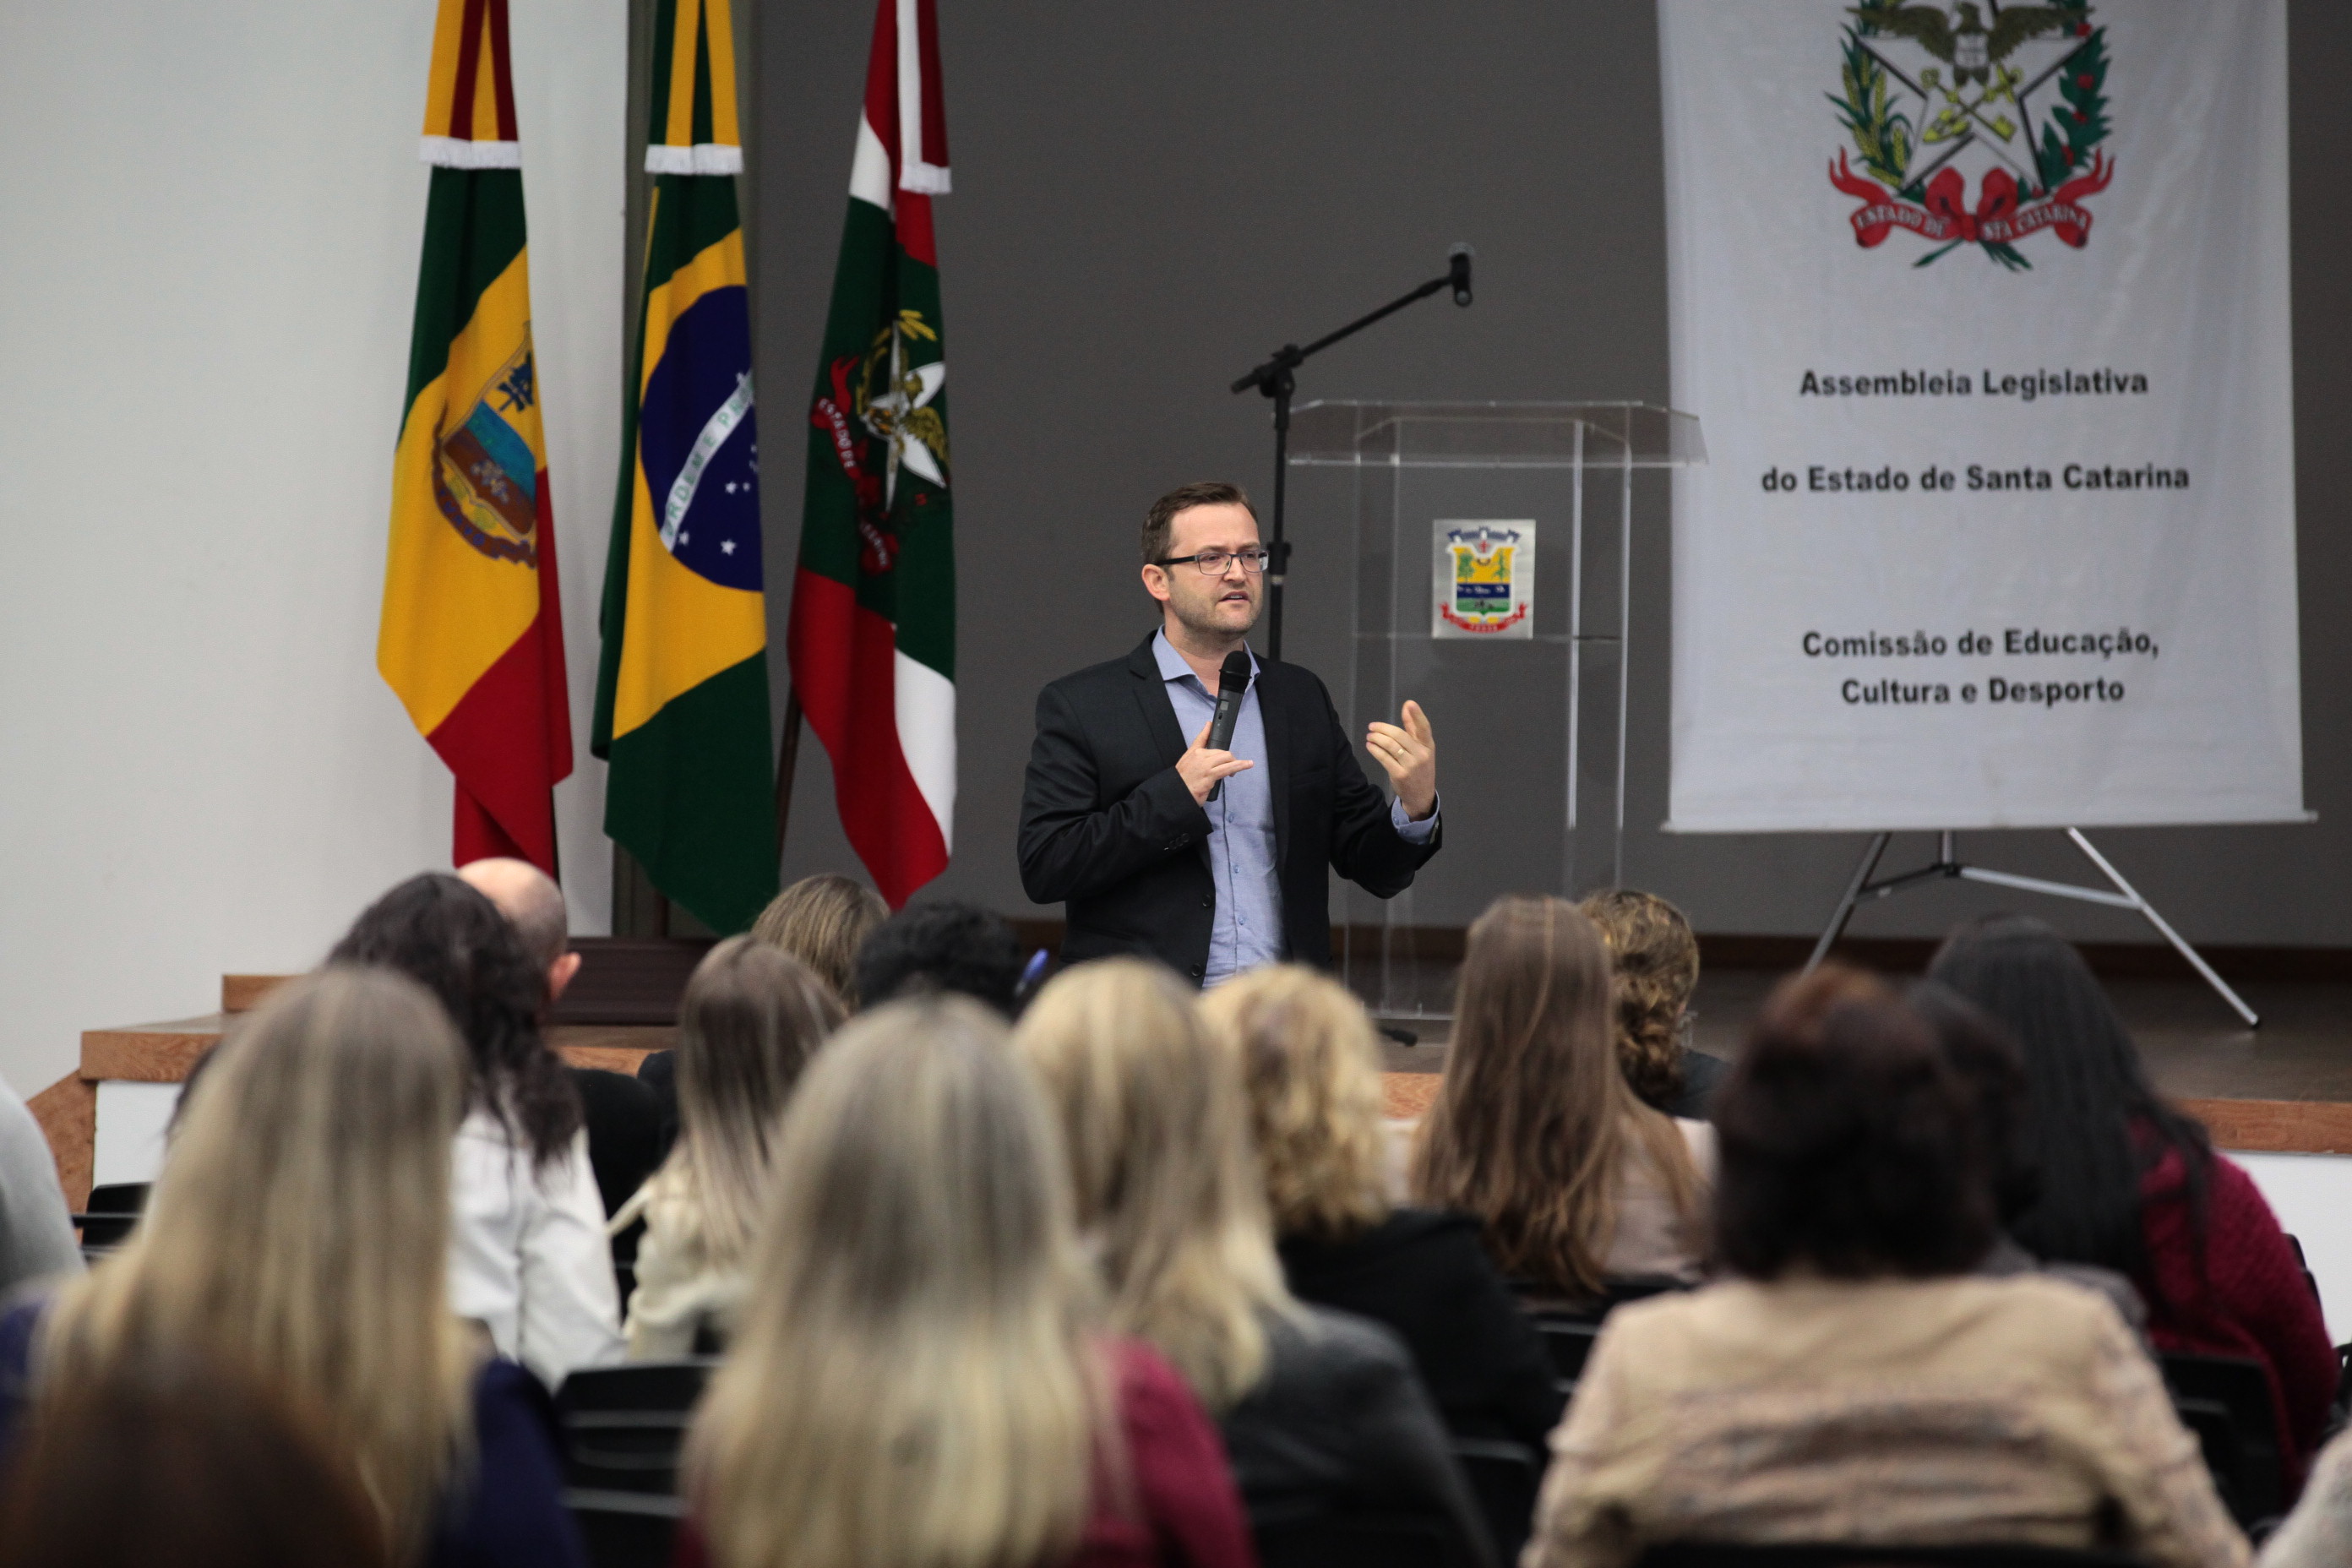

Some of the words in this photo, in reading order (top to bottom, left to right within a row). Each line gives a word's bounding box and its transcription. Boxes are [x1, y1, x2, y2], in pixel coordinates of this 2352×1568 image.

[1856, 204, 1923, 230] ESTADO
[1799, 368, 1973, 397] Assembleia
[1982, 367, 2149, 403] Legislativa
[1761, 466, 1799, 493] do
[1807, 465, 1911, 493] Estado
[1919, 464, 1957, 493] de
[1966, 464, 2053, 492] Santa
[2061, 462, 2190, 491] Catarina
[1801, 629, 1948, 658] Comissão
[1956, 629, 1994, 656] de
[2003, 627, 2159, 661] Educação,
[1840, 678, 1952, 705] Cultura
[1959, 683, 1979, 705] e
[1987, 676, 2126, 710] Desporto
